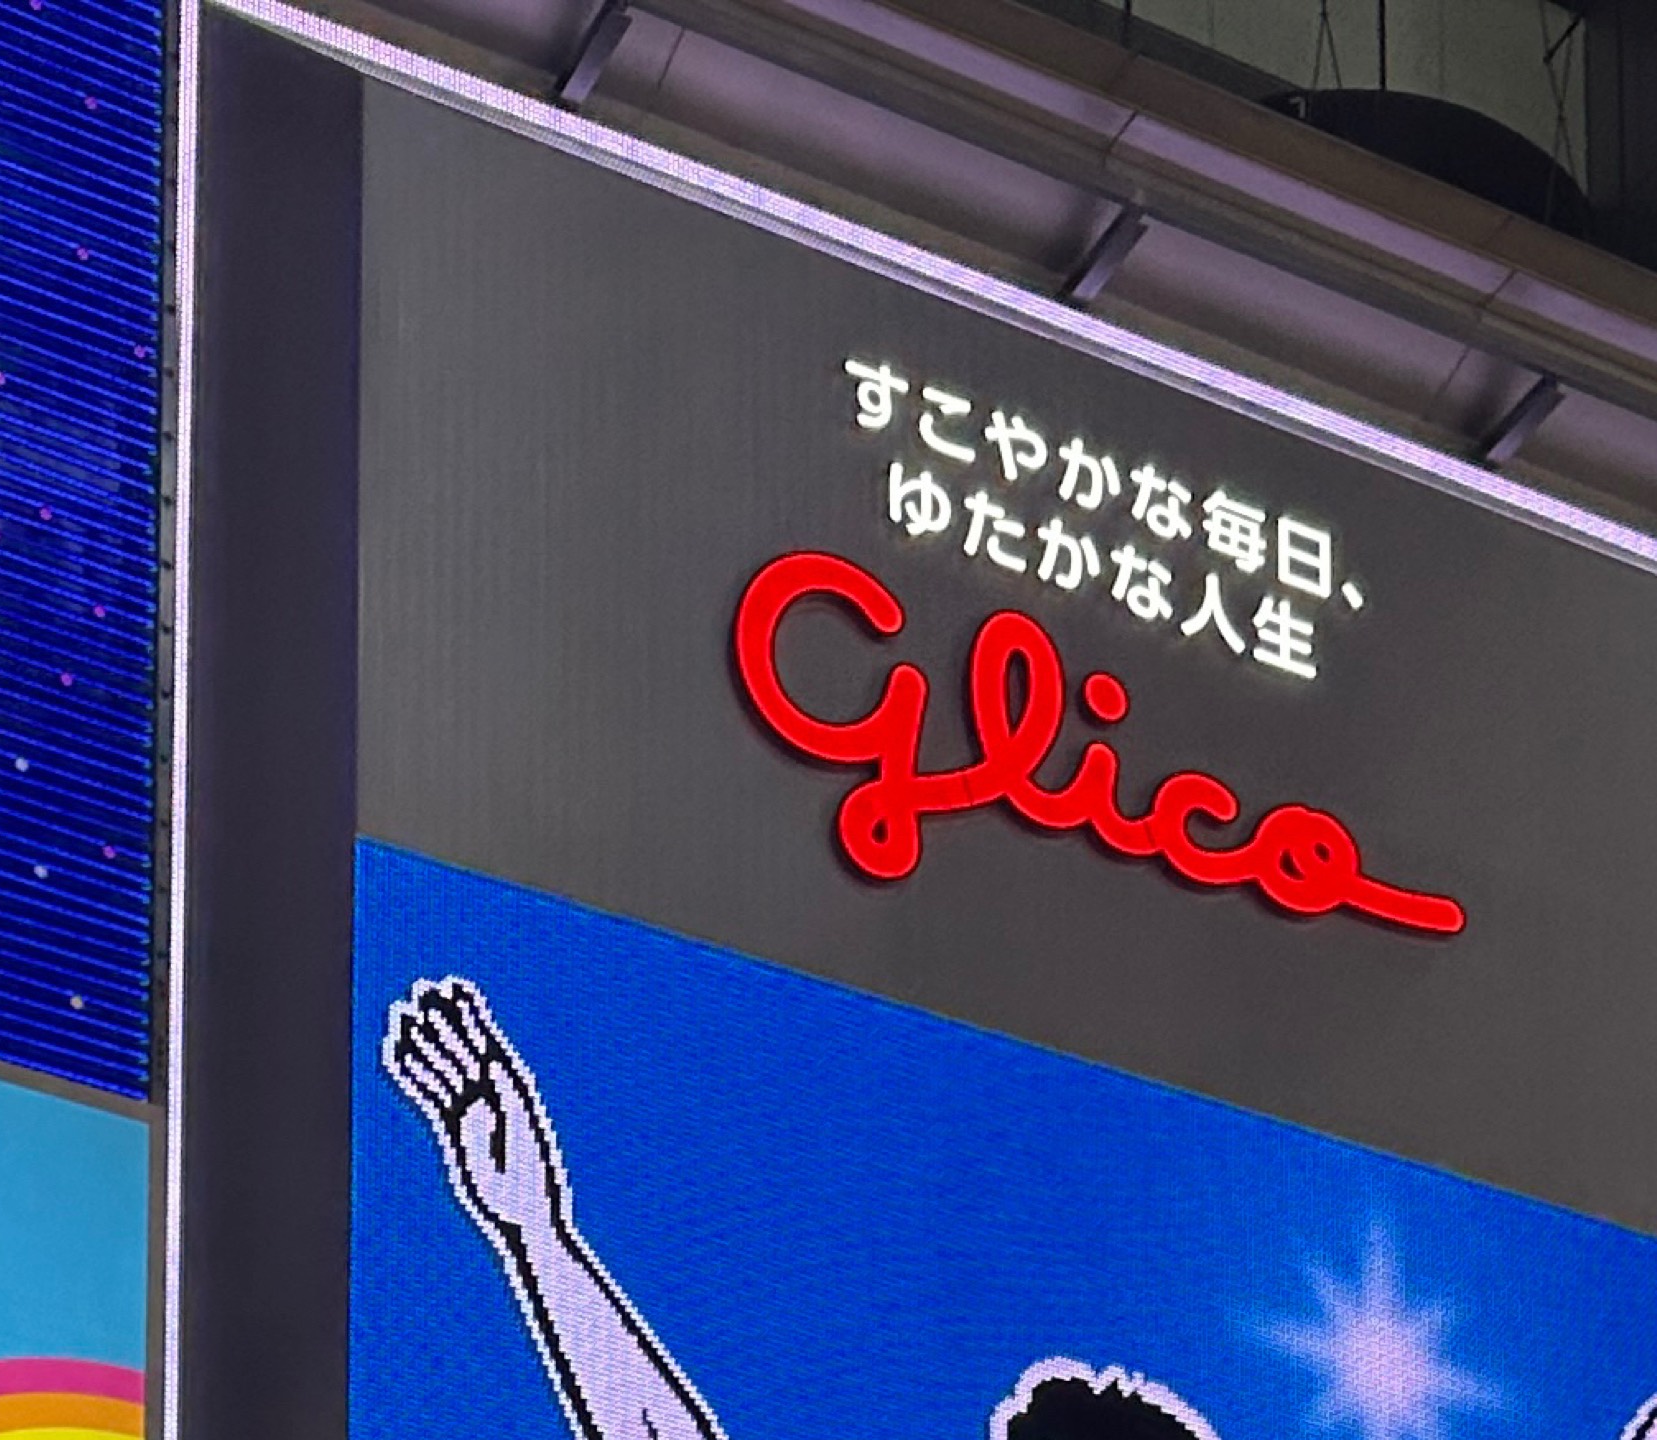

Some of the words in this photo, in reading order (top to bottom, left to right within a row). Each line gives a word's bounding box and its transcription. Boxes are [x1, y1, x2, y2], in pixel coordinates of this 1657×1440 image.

[845, 359, 1366, 611] すこやかな毎日、
[887, 462, 1319, 680] ゆたかな人生
[735, 551, 1466, 934] Glico
